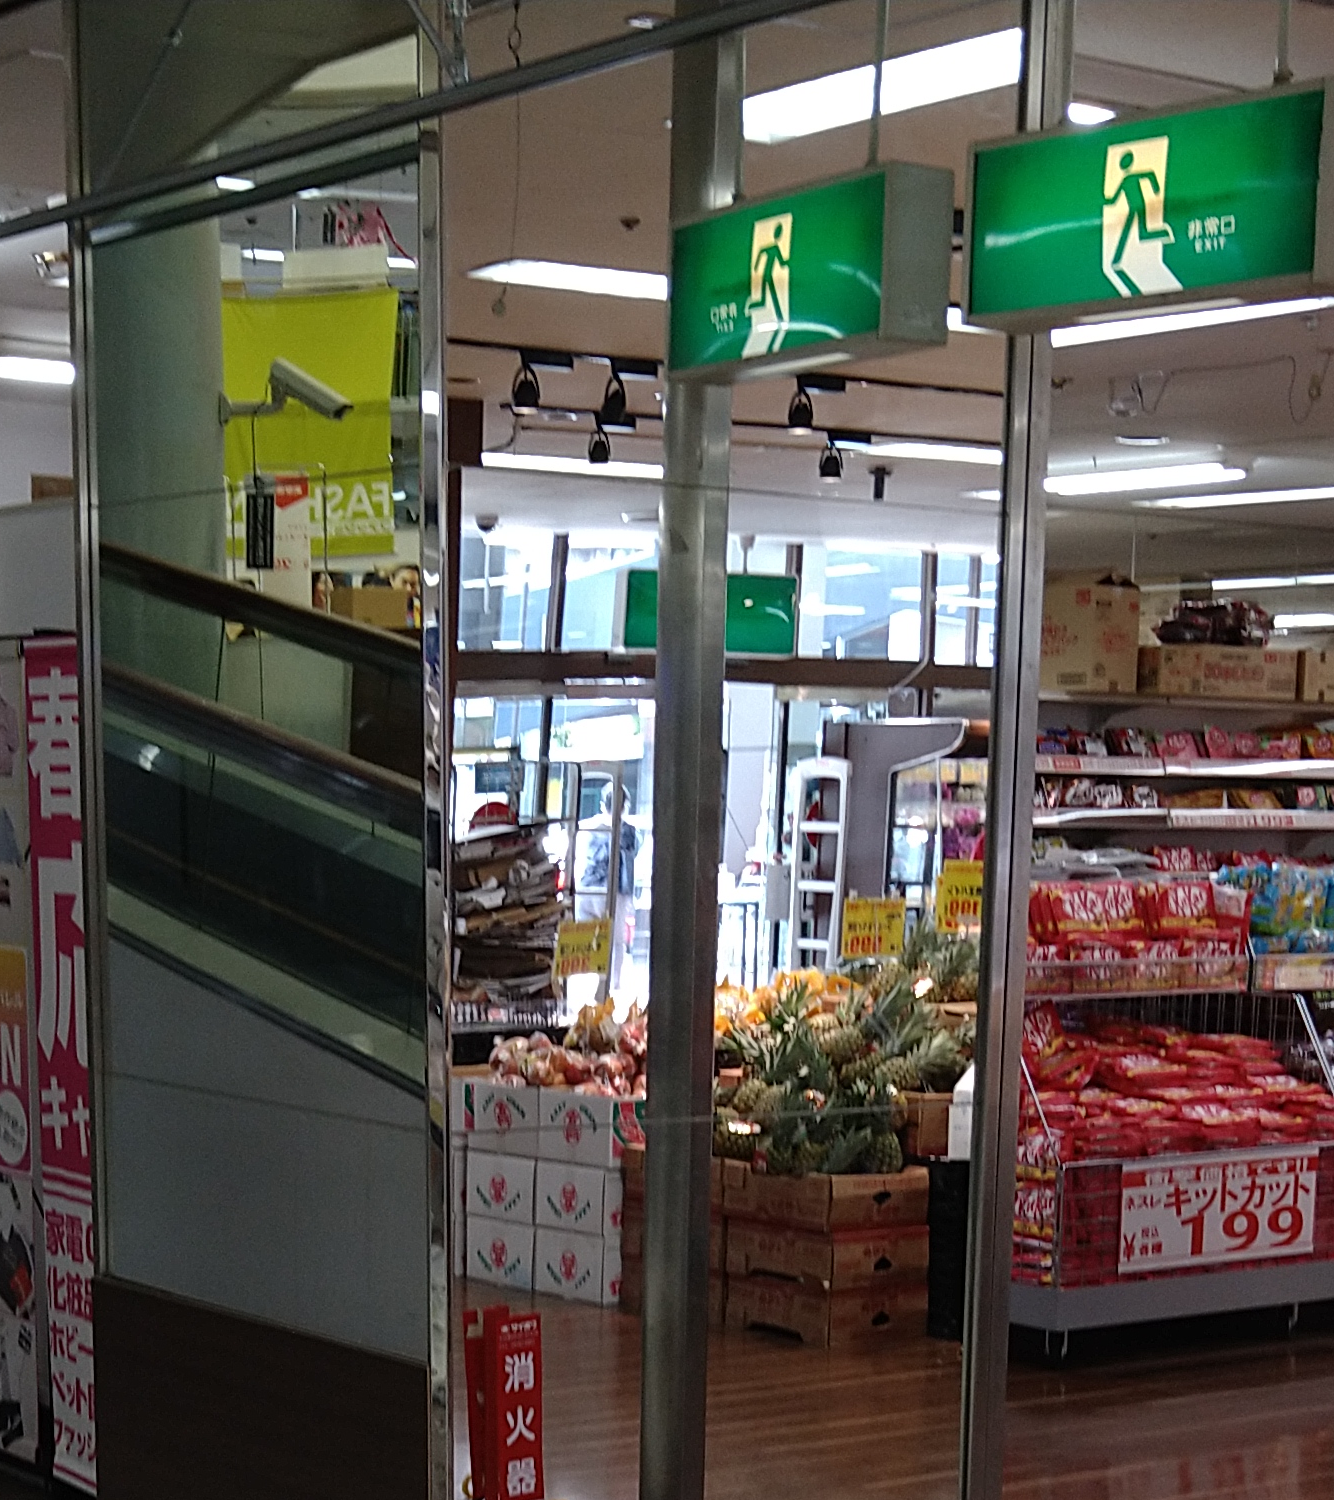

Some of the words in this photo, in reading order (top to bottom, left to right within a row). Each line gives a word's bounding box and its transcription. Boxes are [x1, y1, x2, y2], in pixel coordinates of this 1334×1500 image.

[1187, 214, 1236, 241] 非常口
[1194, 235, 1226, 254] EXIT
[1163, 1173, 1310, 1217] キットカット
[1181, 1206, 1304, 1256] 199
[503, 1350, 538, 1498] 消火器
